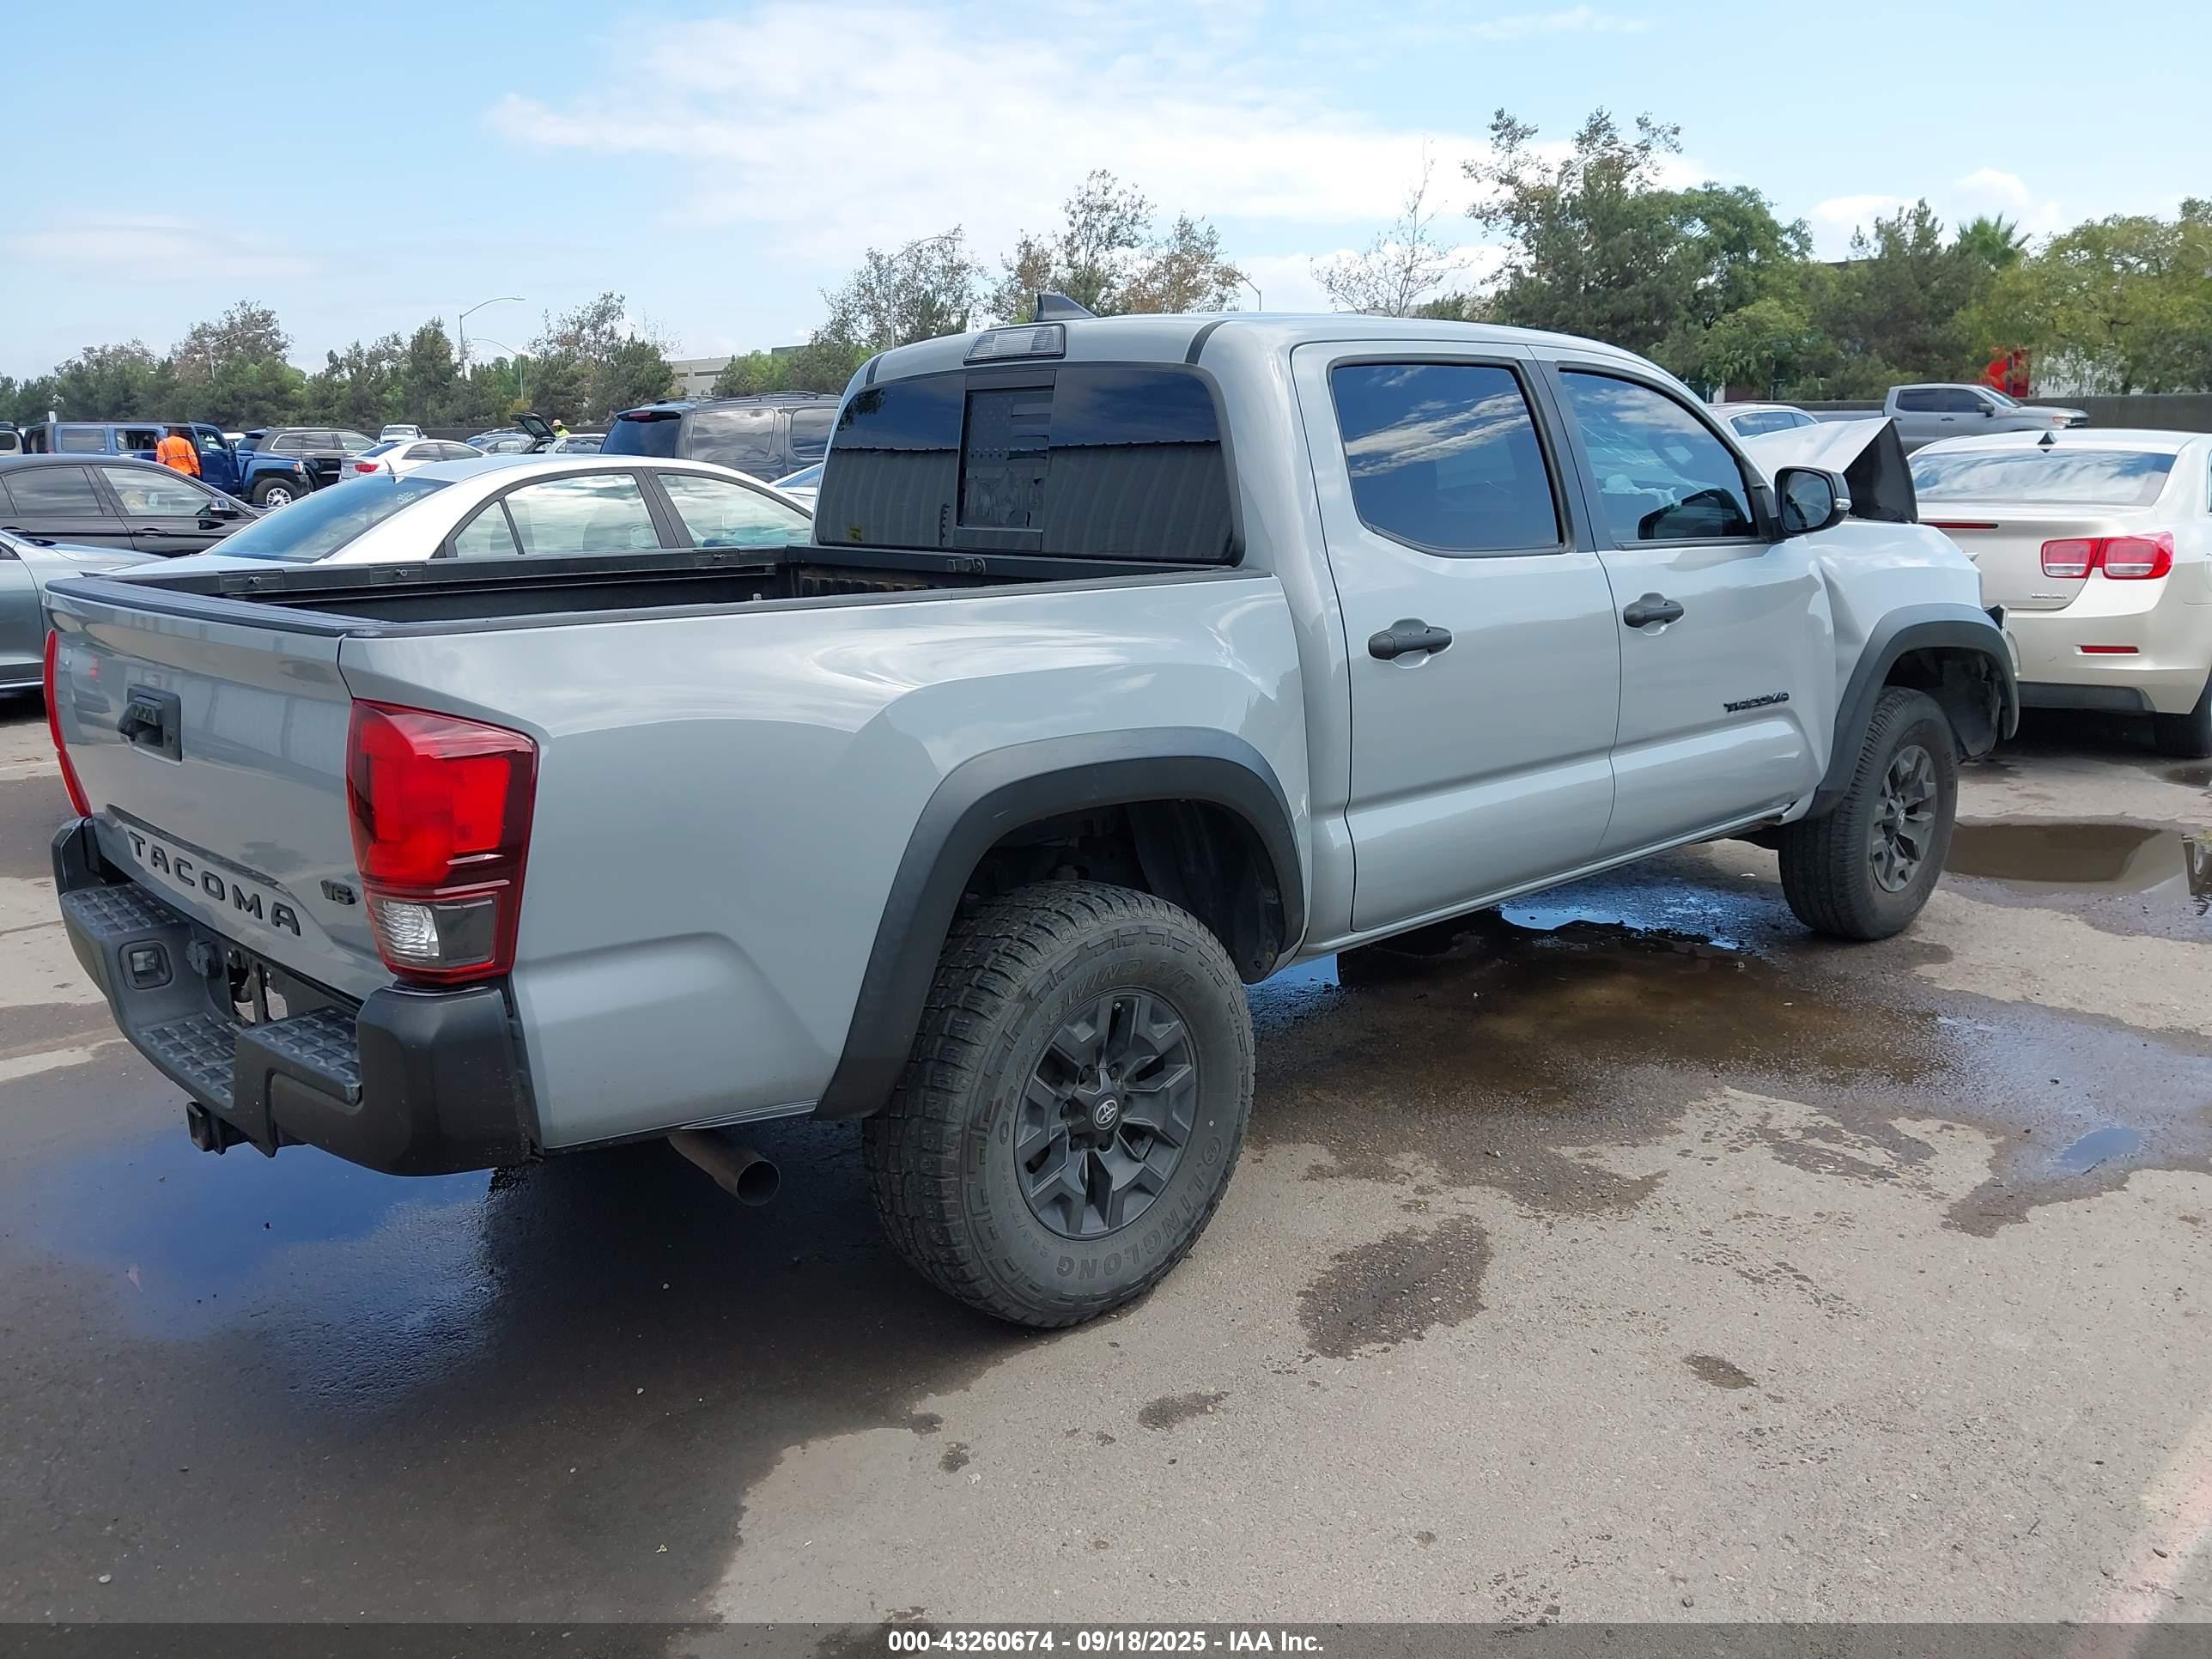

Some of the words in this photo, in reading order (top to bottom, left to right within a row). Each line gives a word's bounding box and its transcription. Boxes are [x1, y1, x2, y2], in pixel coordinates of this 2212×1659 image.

[1723, 692, 1790, 713] TACOMA
[128, 831, 301, 937] TACOMA
[320, 878, 356, 906] V6
[1056, 1174, 1206, 1280] LINGLONG
